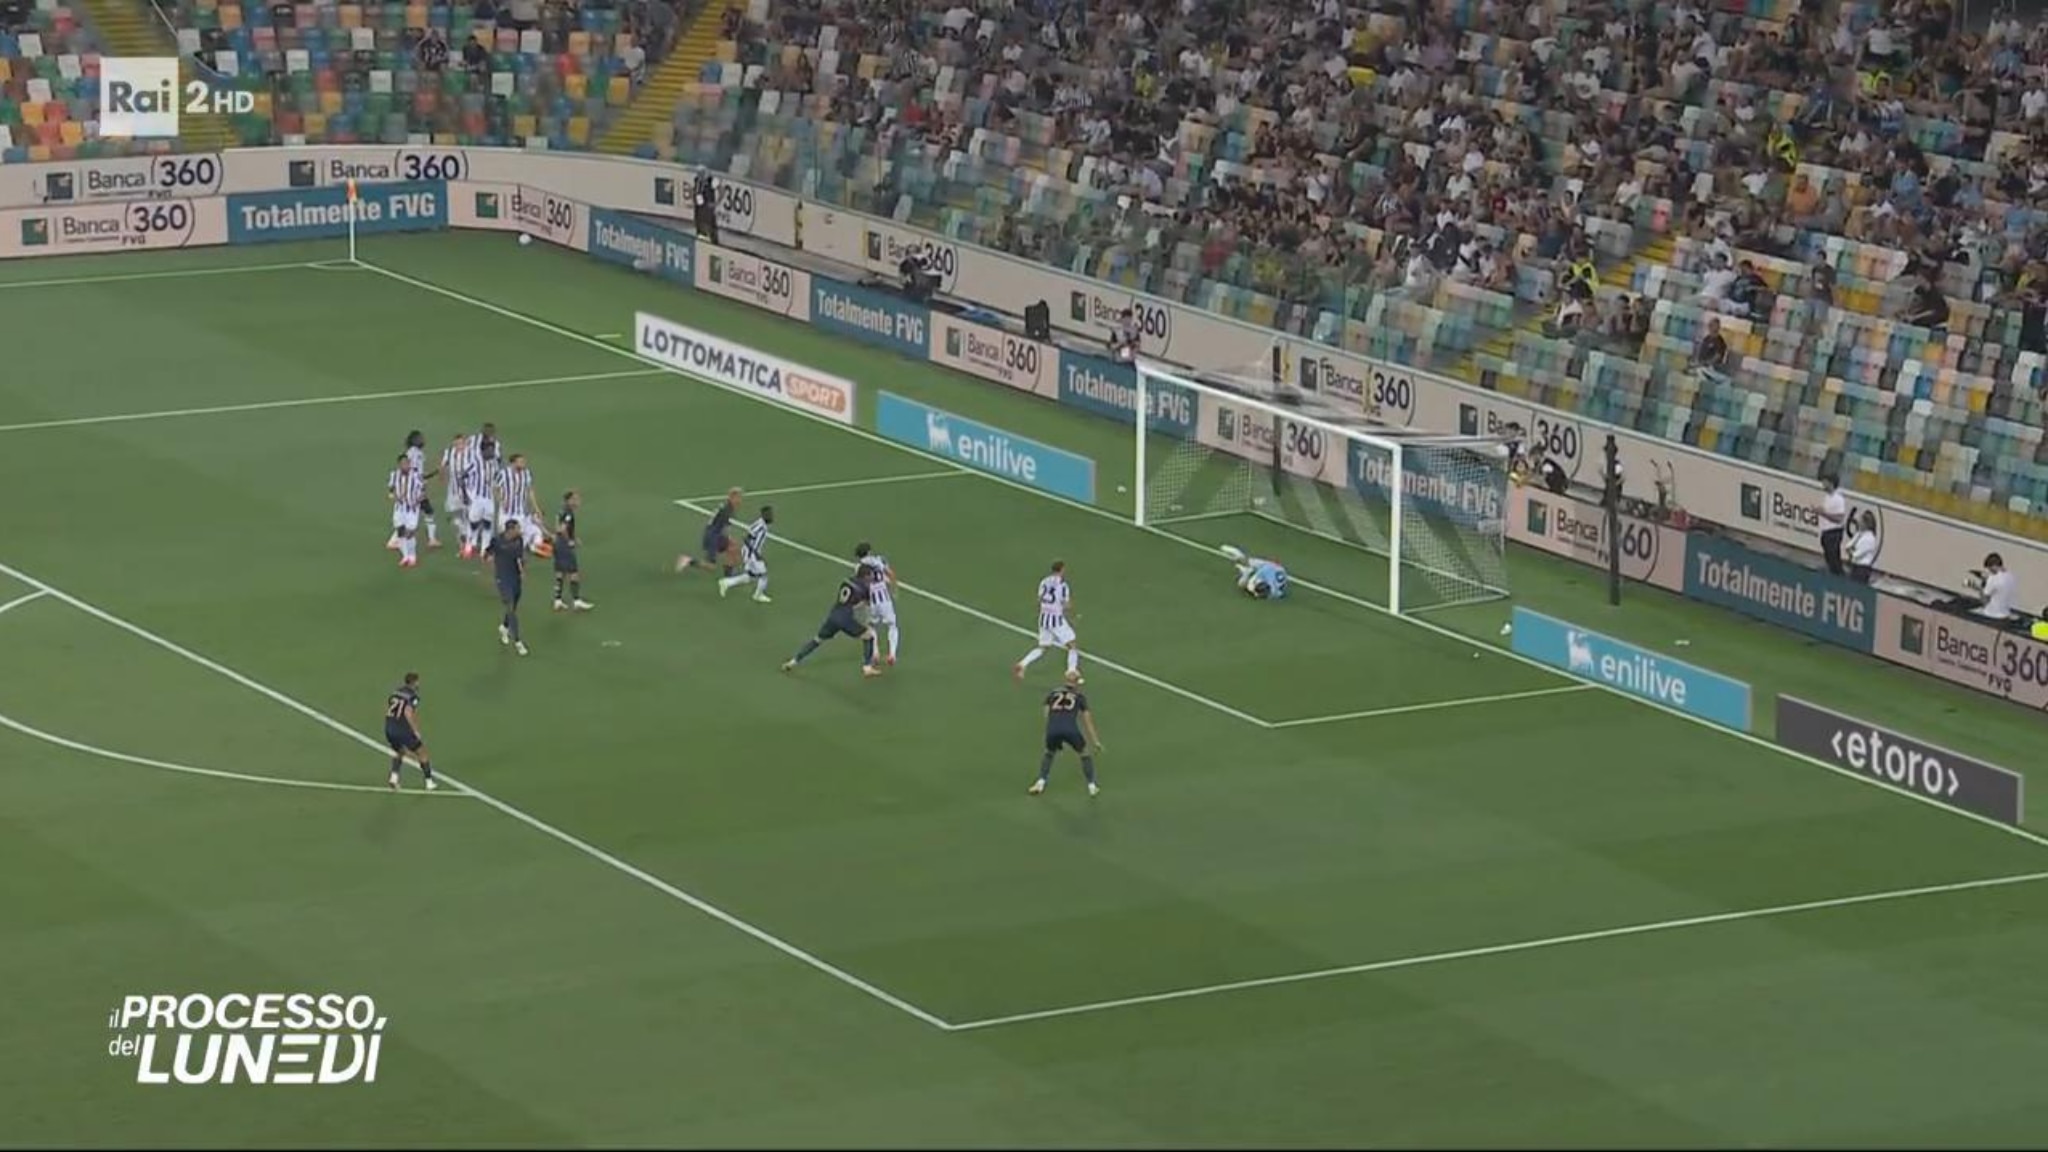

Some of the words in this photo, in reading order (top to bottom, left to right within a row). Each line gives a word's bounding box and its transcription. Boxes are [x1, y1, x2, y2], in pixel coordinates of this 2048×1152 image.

[88, 169, 146, 190] Banca
[331, 160, 389, 179] Banca
[62, 217, 120, 236] Banca
[241, 197, 382, 230] Totalmente
[389, 192, 435, 219] FVG
[666, 242, 689, 271] FVG
[728, 263, 756, 286] Banca
[817, 289, 892, 335] Totalmente
[896, 314, 922, 344] FVG
[967, 333, 999, 362] Banca
[643, 325, 781, 393] LOTTOMATICA
[787, 375, 843, 408] SPORT
[1326, 365, 1363, 395] Banca
[1157, 390, 1190, 425] FVG
[958, 434, 1036, 480] enilive
[1557, 508, 1598, 542] Banca
[1773, 492, 1819, 527] Banca
[1697, 552, 1815, 618] Totalmente
[1822, 590, 1864, 633] FVG
[1937, 626, 1988, 665] Banca
[1601, 654, 1687, 704] enilive
[1052, 692, 1076, 710] 25
